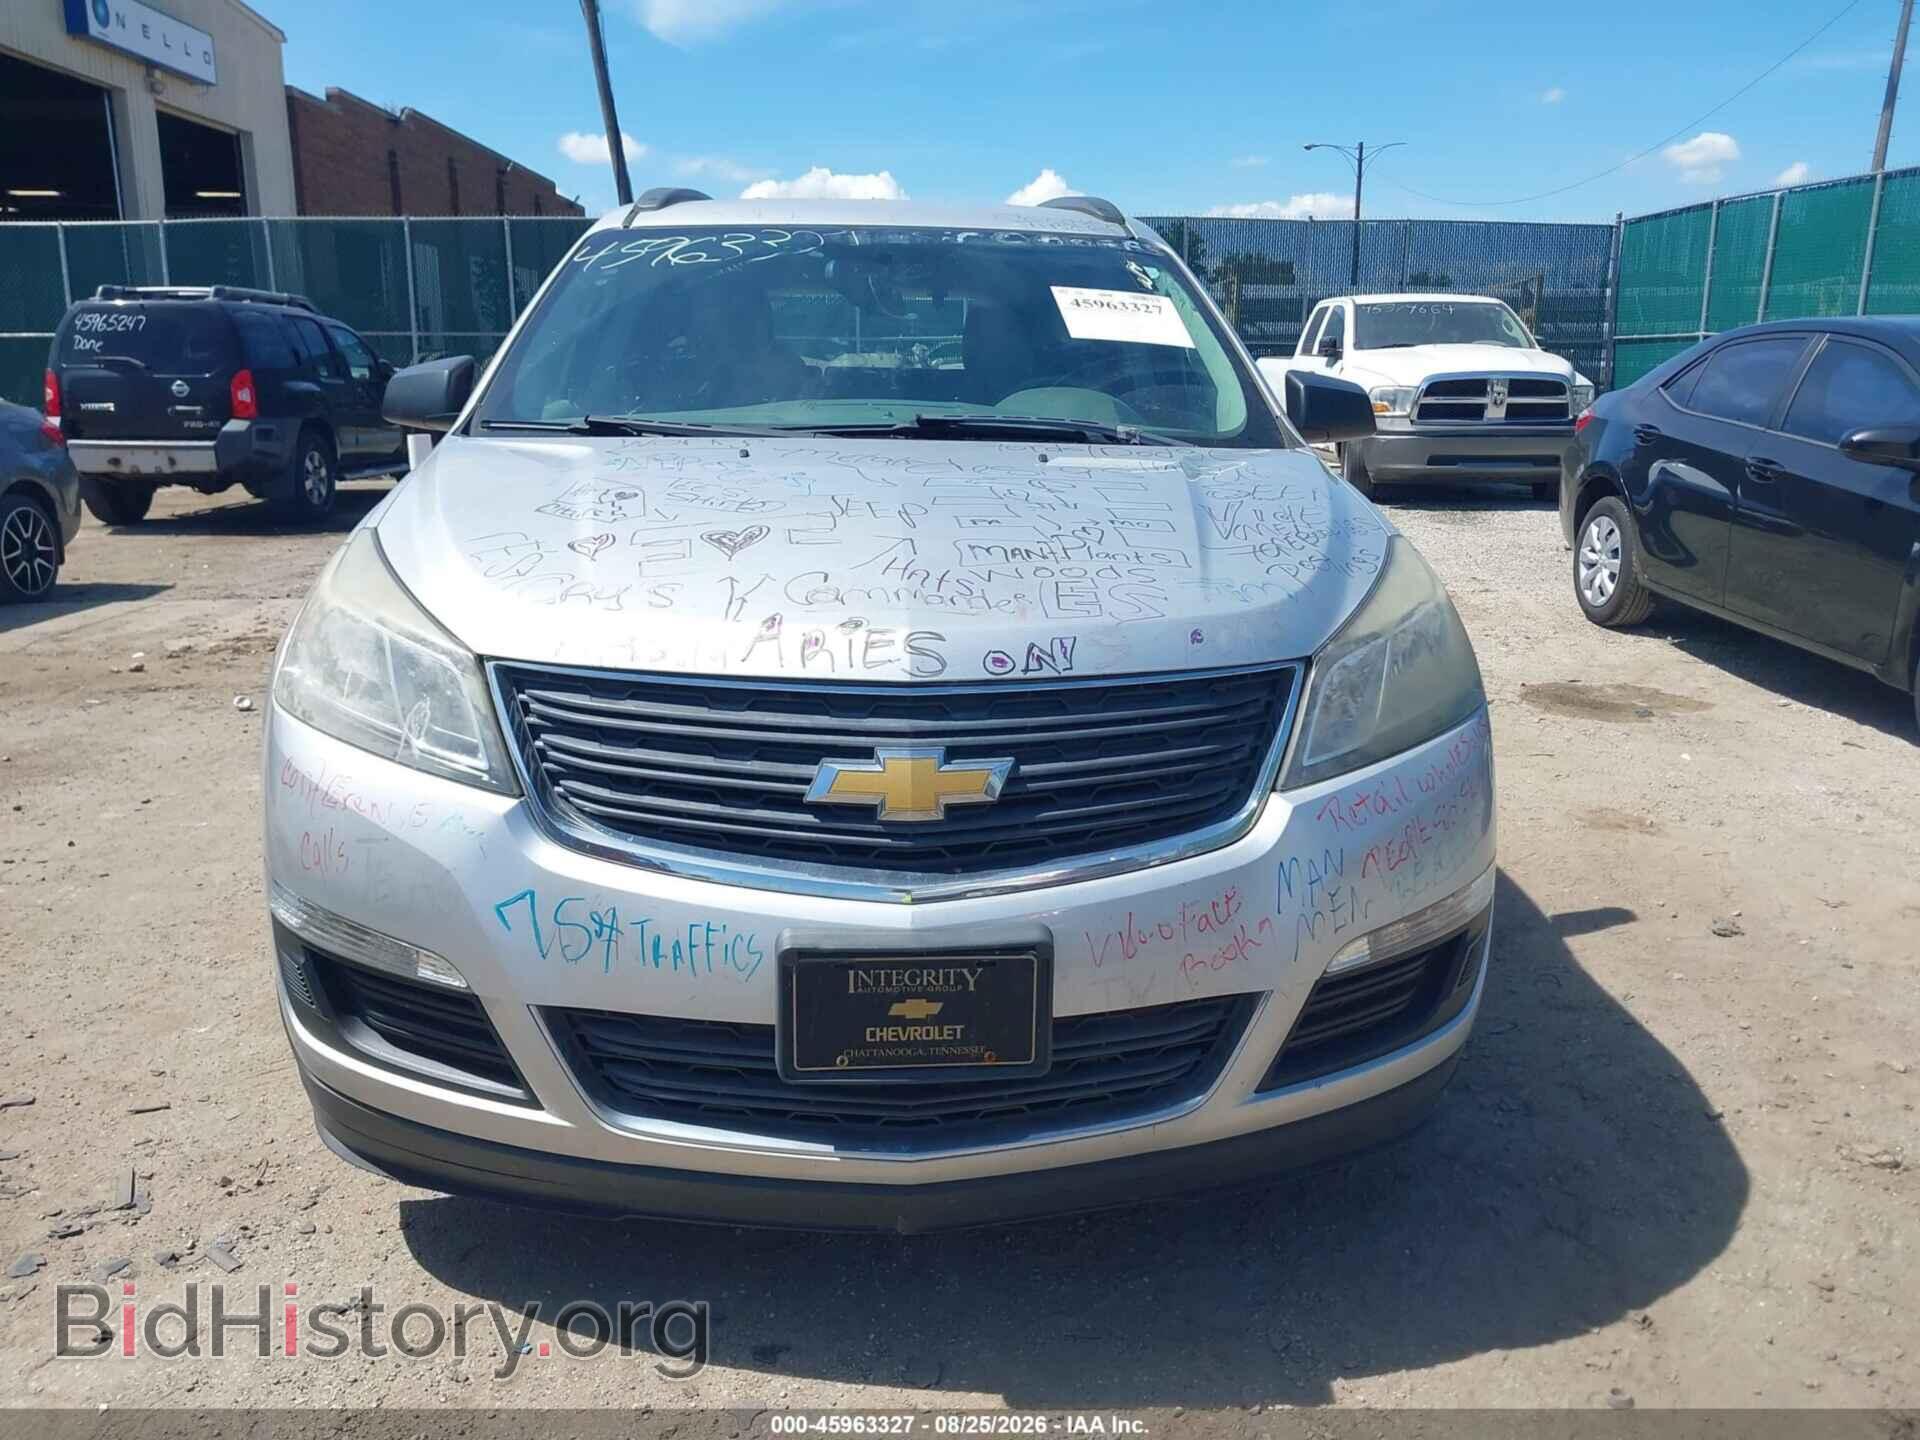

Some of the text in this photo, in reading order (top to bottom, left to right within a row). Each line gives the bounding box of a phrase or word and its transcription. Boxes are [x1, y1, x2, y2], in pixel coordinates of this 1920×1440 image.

[1070, 297, 1163, 317] 45963327
[73, 312, 147, 333] 45965247
[73, 334, 104, 352] Done
[847, 967, 984, 993] INTEGRITY
[865, 1024, 966, 1042] CHEVROLET
